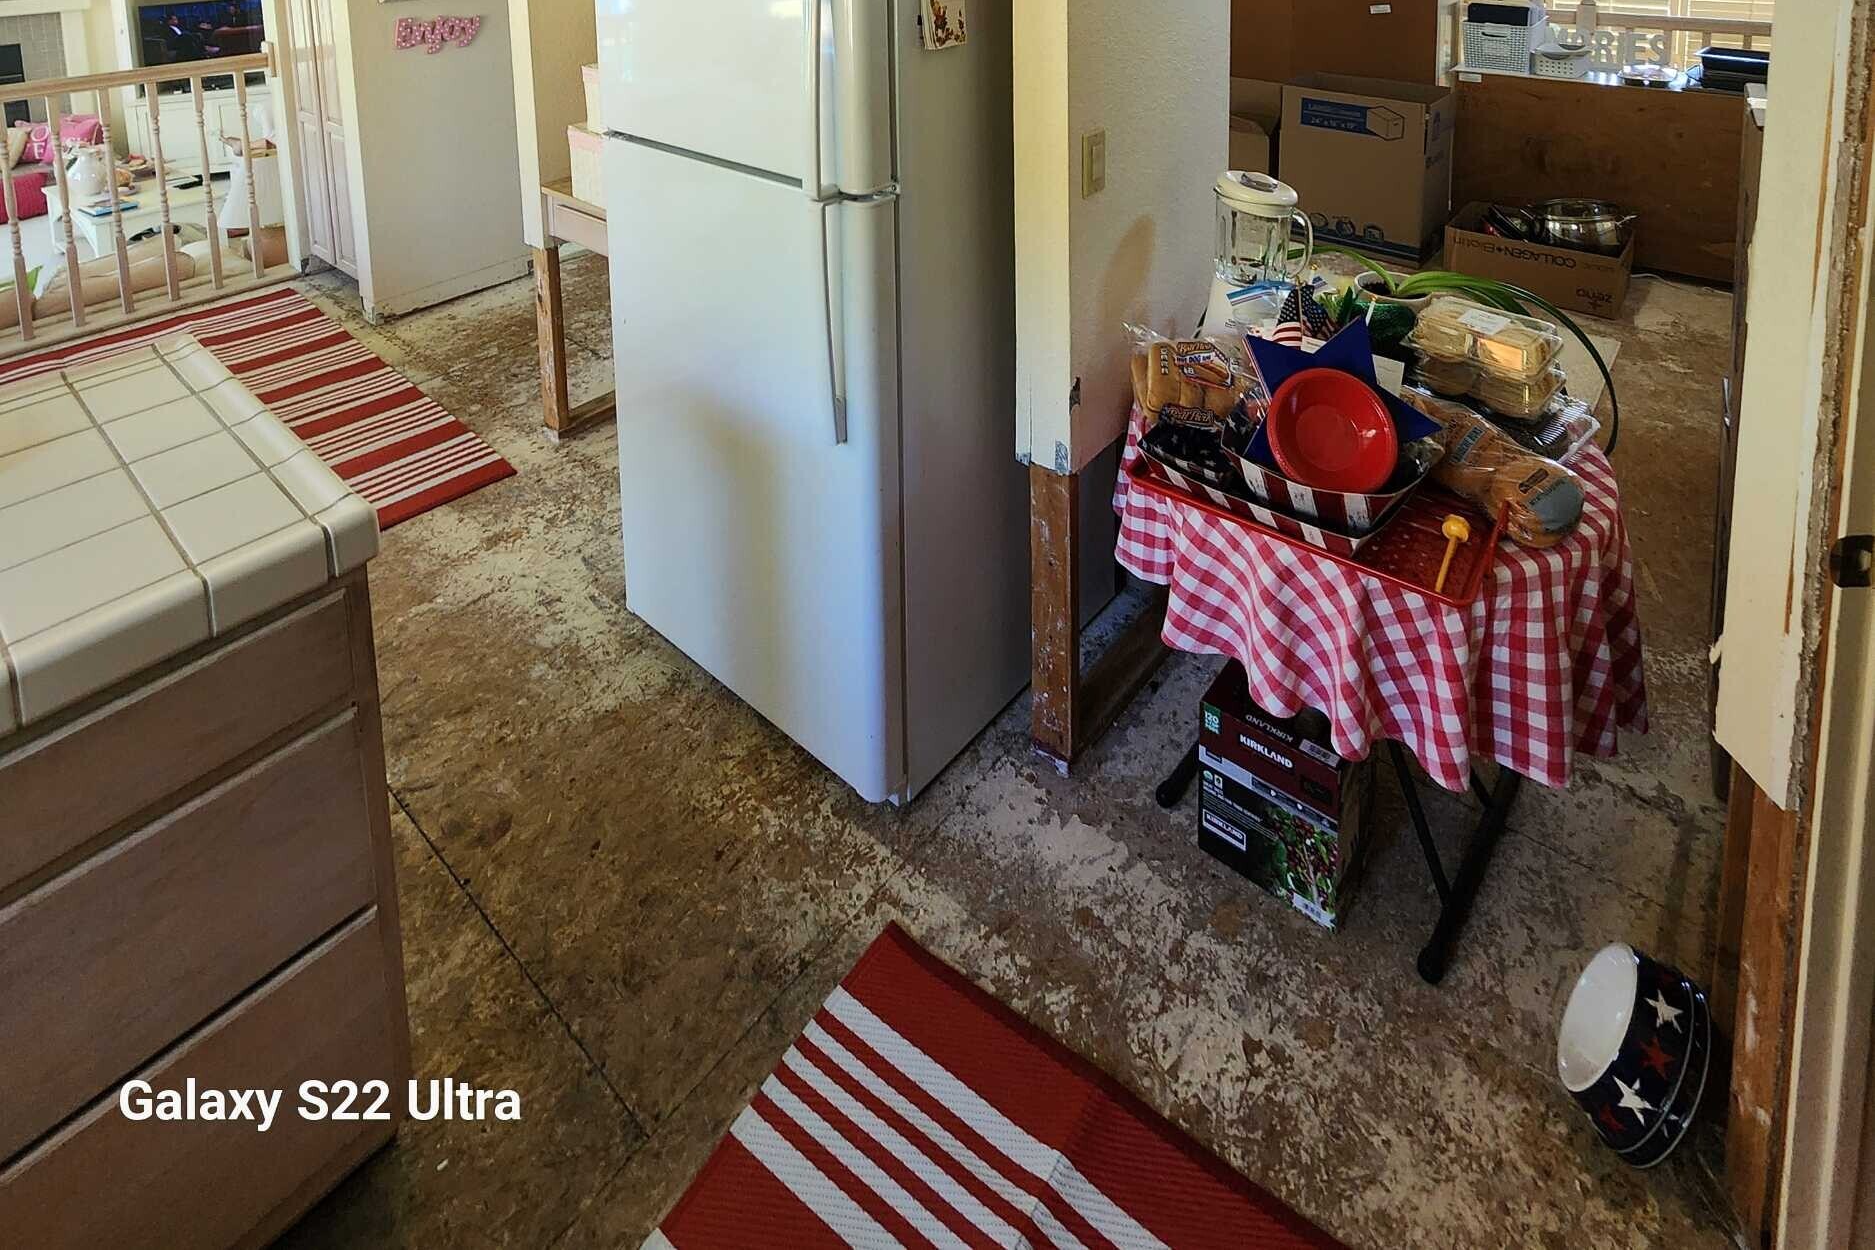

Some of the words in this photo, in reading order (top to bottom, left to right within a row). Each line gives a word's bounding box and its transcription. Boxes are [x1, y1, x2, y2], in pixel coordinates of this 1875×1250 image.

[395, 14, 481, 54] Enjoy
[1204, 710, 1219, 724] 120
[1245, 713, 1294, 743] KIRKLAND
[1239, 734, 1294, 769] KIRKLAND
[1206, 813, 1243, 840] KIRKLAND
